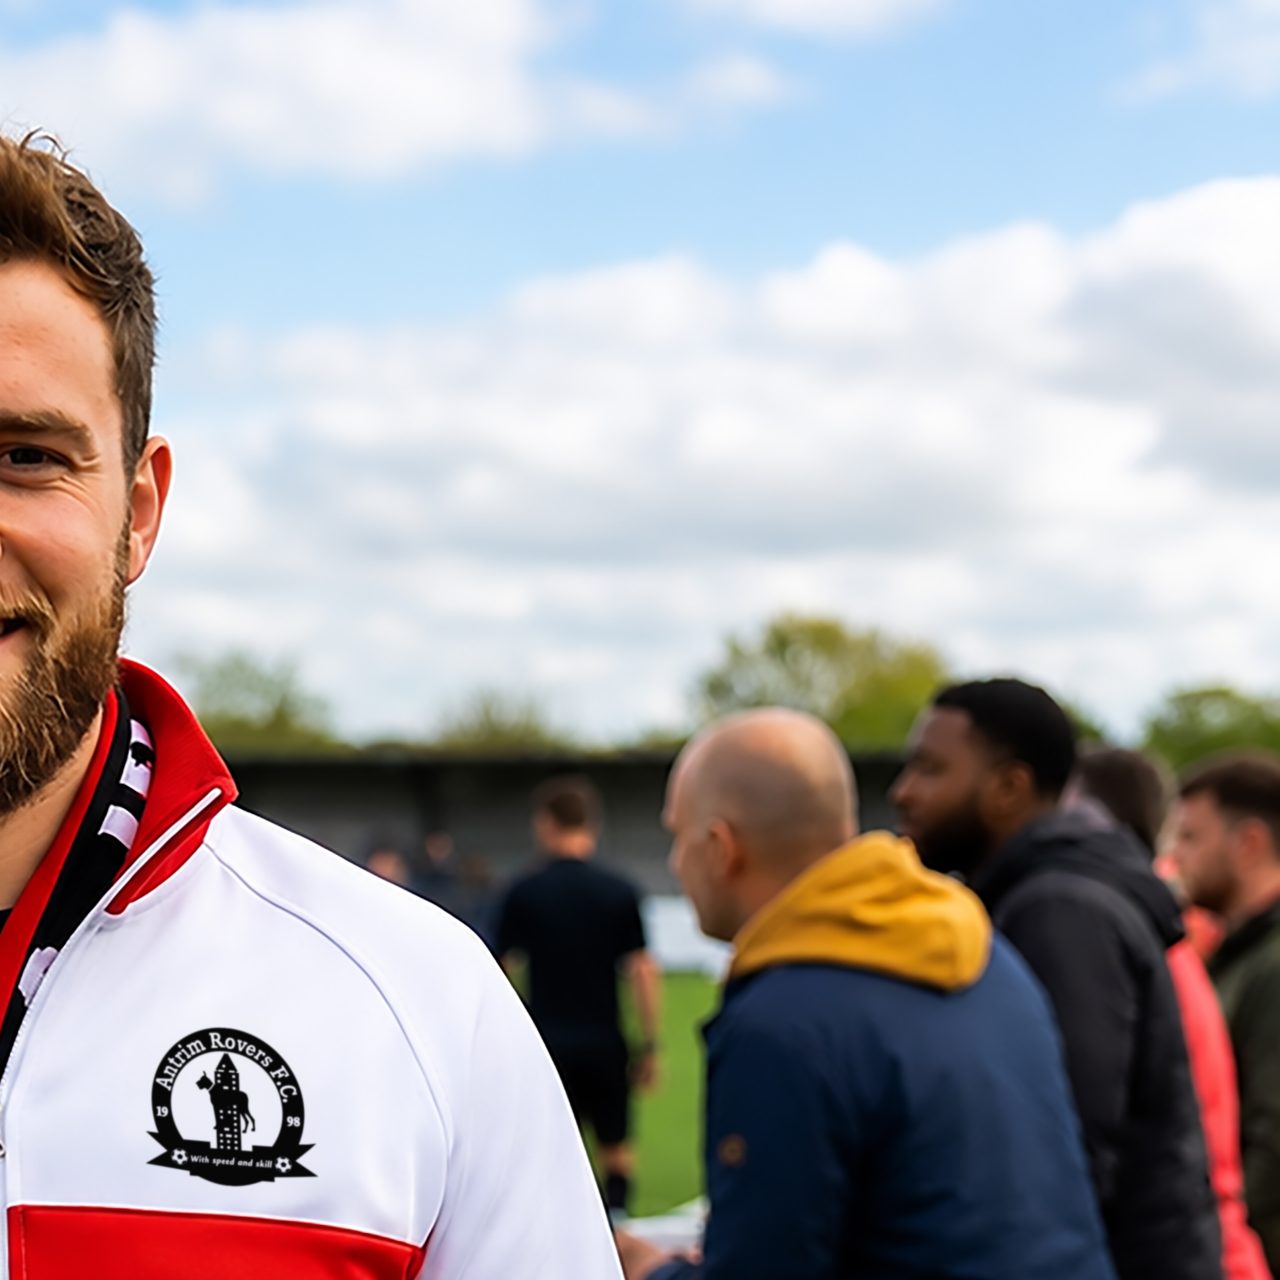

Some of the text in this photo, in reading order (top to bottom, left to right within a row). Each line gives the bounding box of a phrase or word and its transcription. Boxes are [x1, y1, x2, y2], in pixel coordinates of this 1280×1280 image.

[155, 1032, 298, 1104] Antrim Rovers F.C.
[156, 1106, 169, 1118] 19
[286, 1116, 301, 1128] 98
[190, 1154, 273, 1169] With speed and skill
